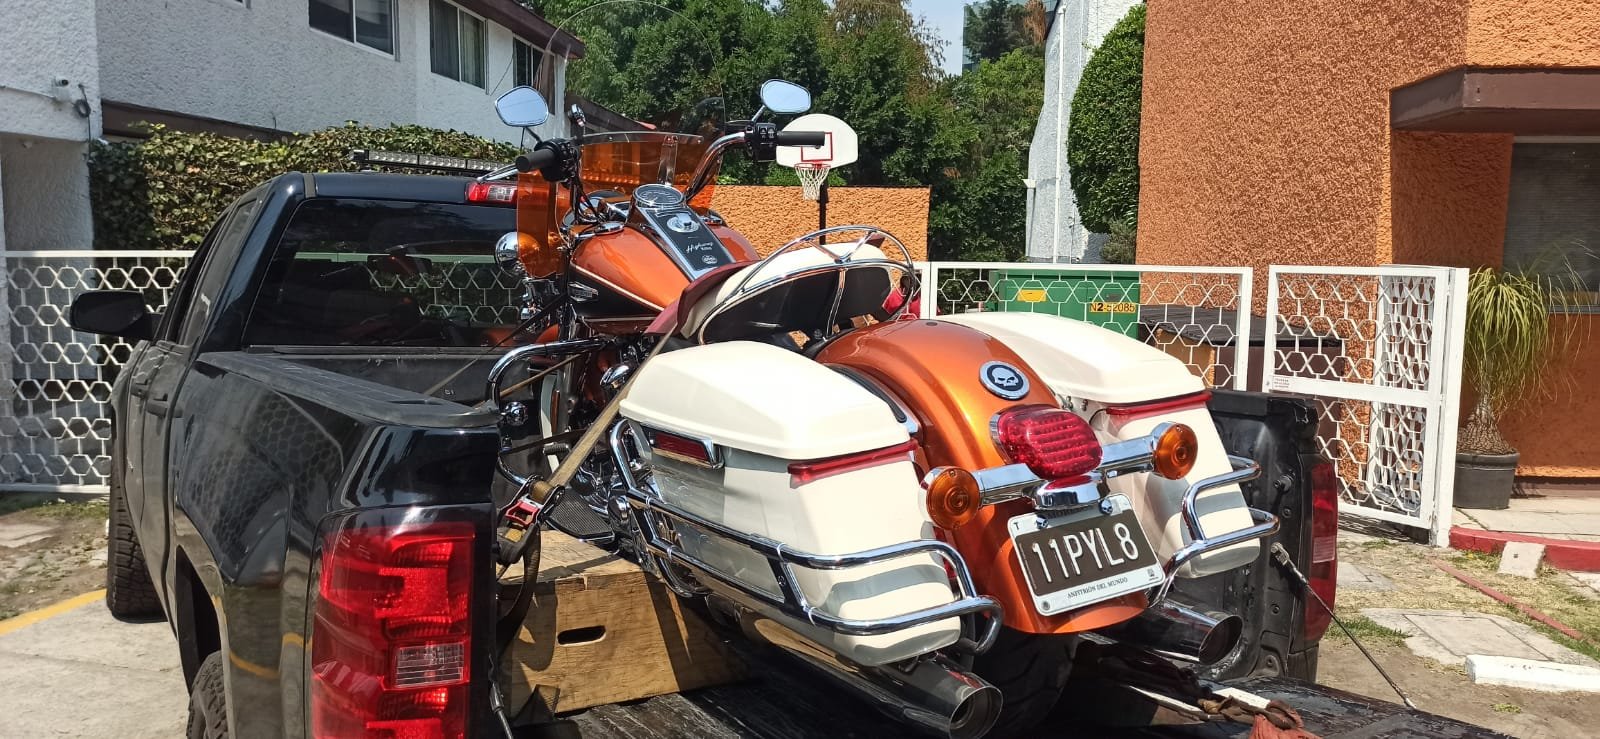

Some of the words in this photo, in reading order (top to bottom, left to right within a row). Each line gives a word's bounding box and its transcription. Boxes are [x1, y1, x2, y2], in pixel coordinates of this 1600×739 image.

[1013, 521, 1020, 531] T
[1032, 522, 1139, 583] 11PYL8
[1096, 583, 1107, 591] DEL
[1107, 577, 1128, 588] MUNDO
